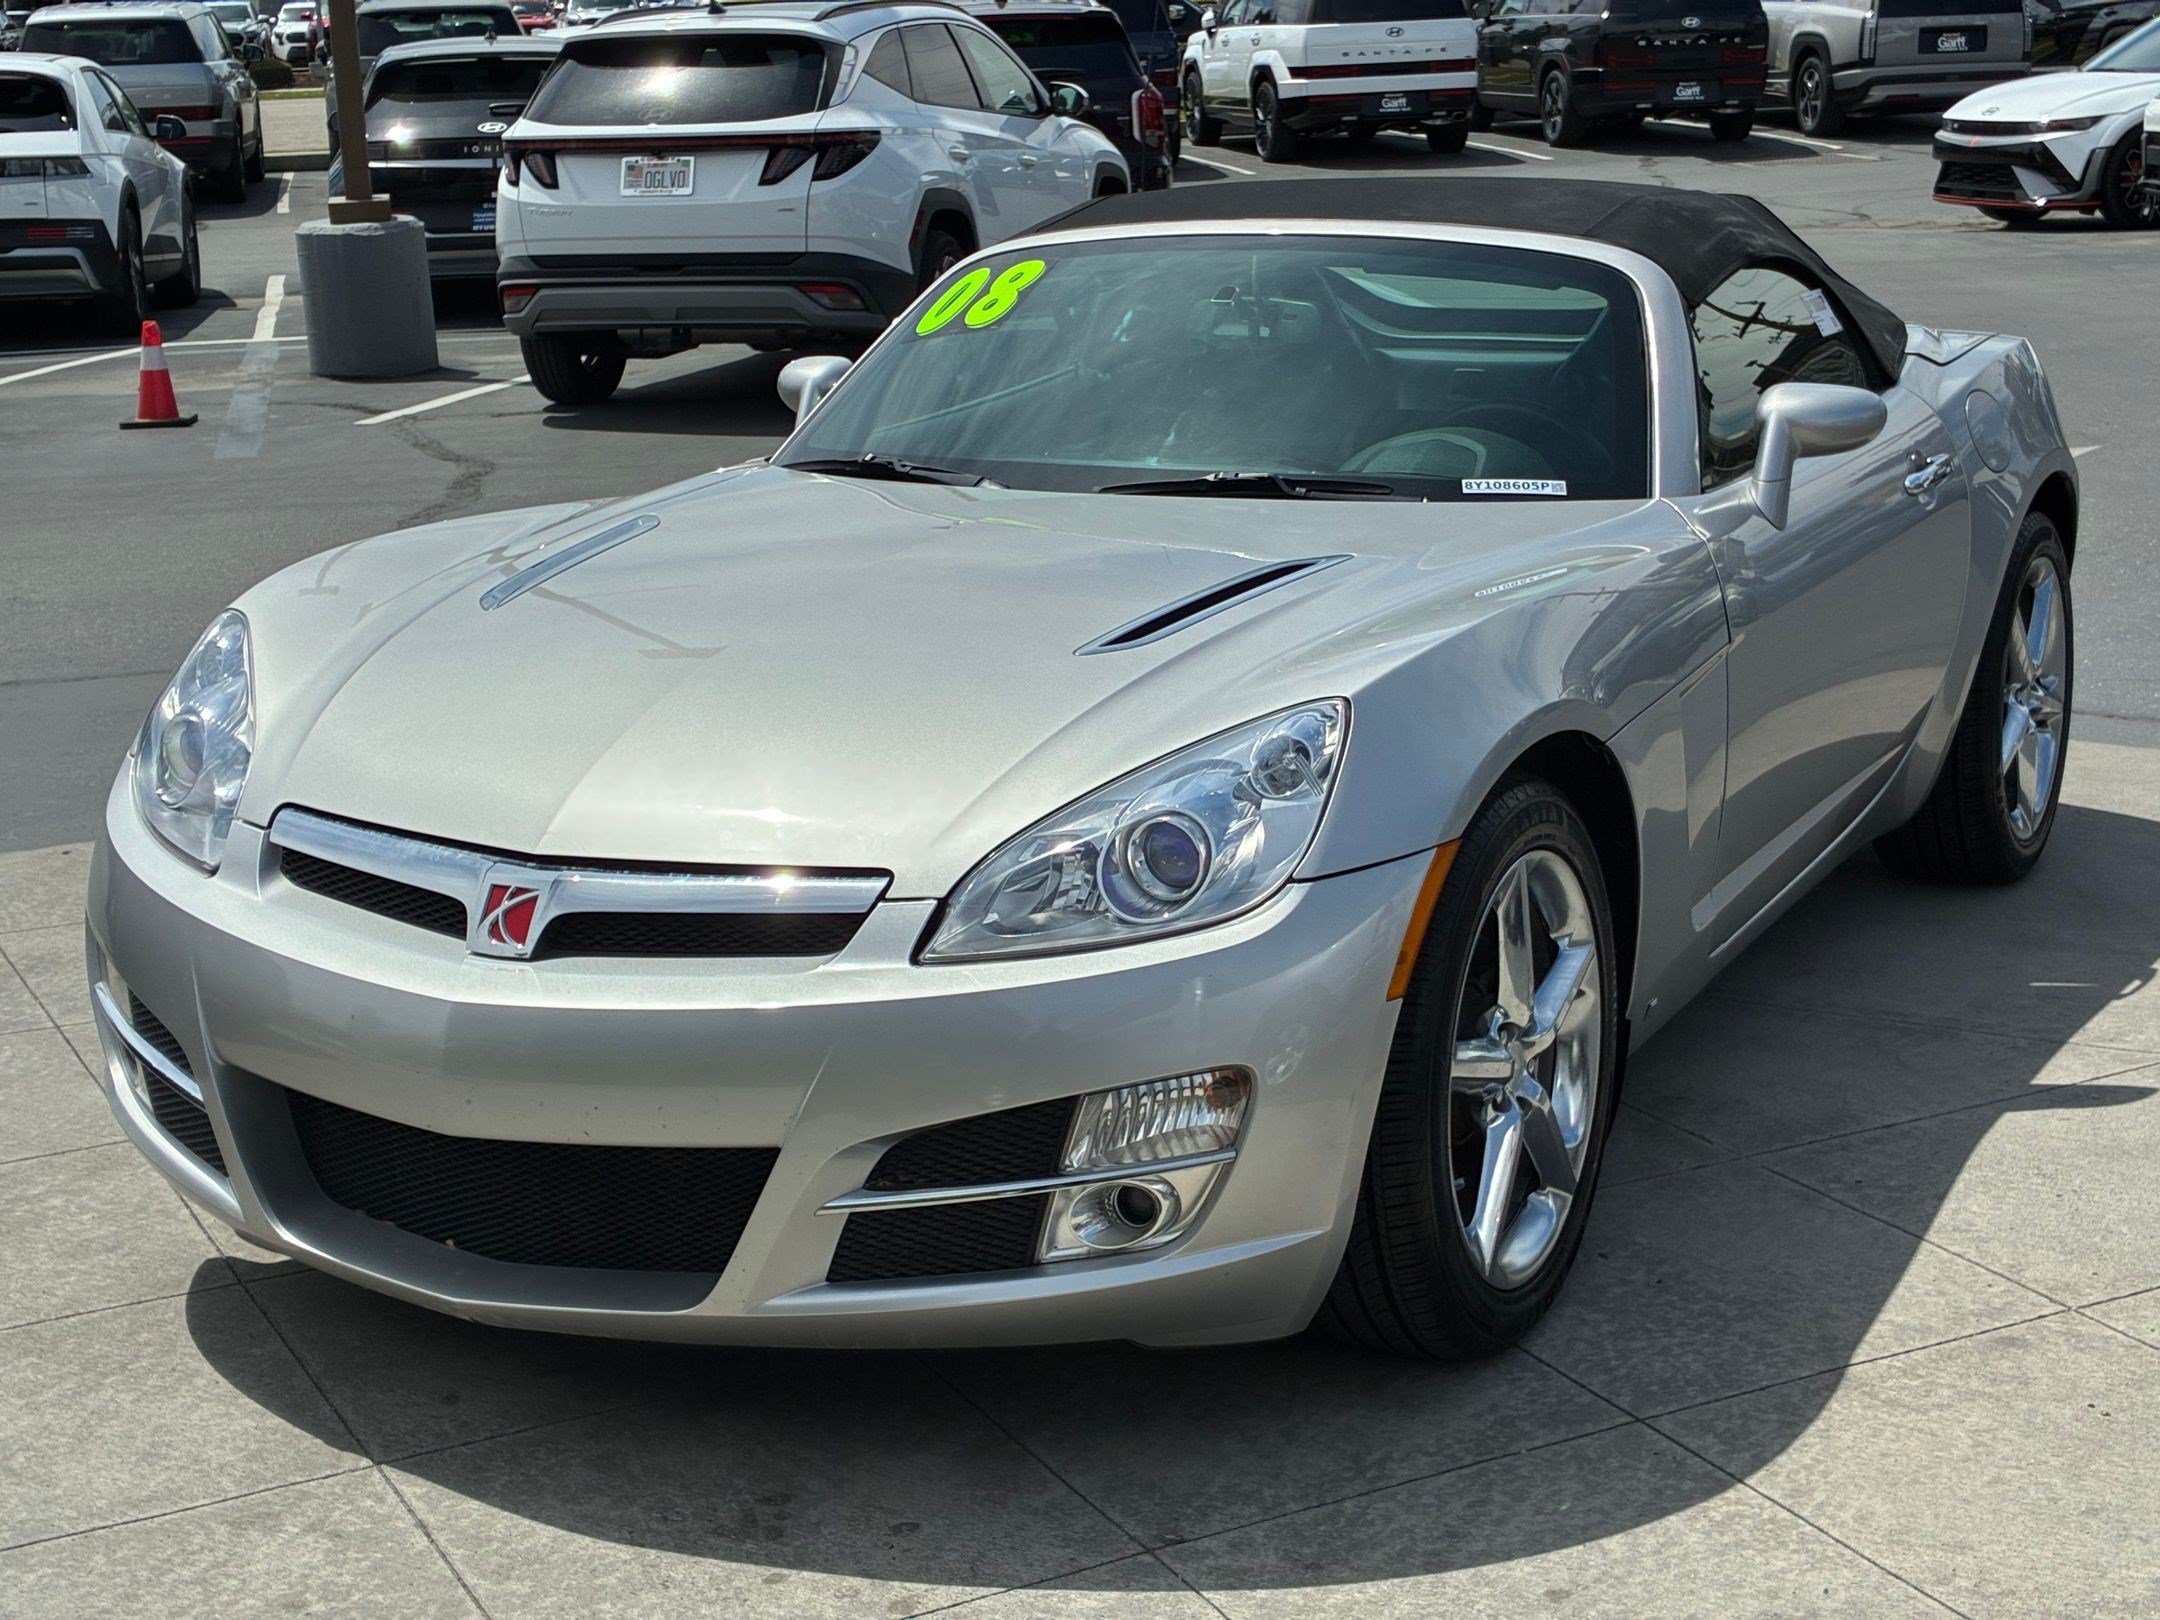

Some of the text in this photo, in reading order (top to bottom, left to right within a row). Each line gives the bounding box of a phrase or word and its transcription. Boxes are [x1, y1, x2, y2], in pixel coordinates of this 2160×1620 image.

[1637, 39, 1708, 47] SANTA
[1341, 49, 1412, 58] SANTA
[463, 144, 500, 154] IONI
[916, 260, 1046, 336] 08
[1464, 481, 1550, 491] 8Y108605P
